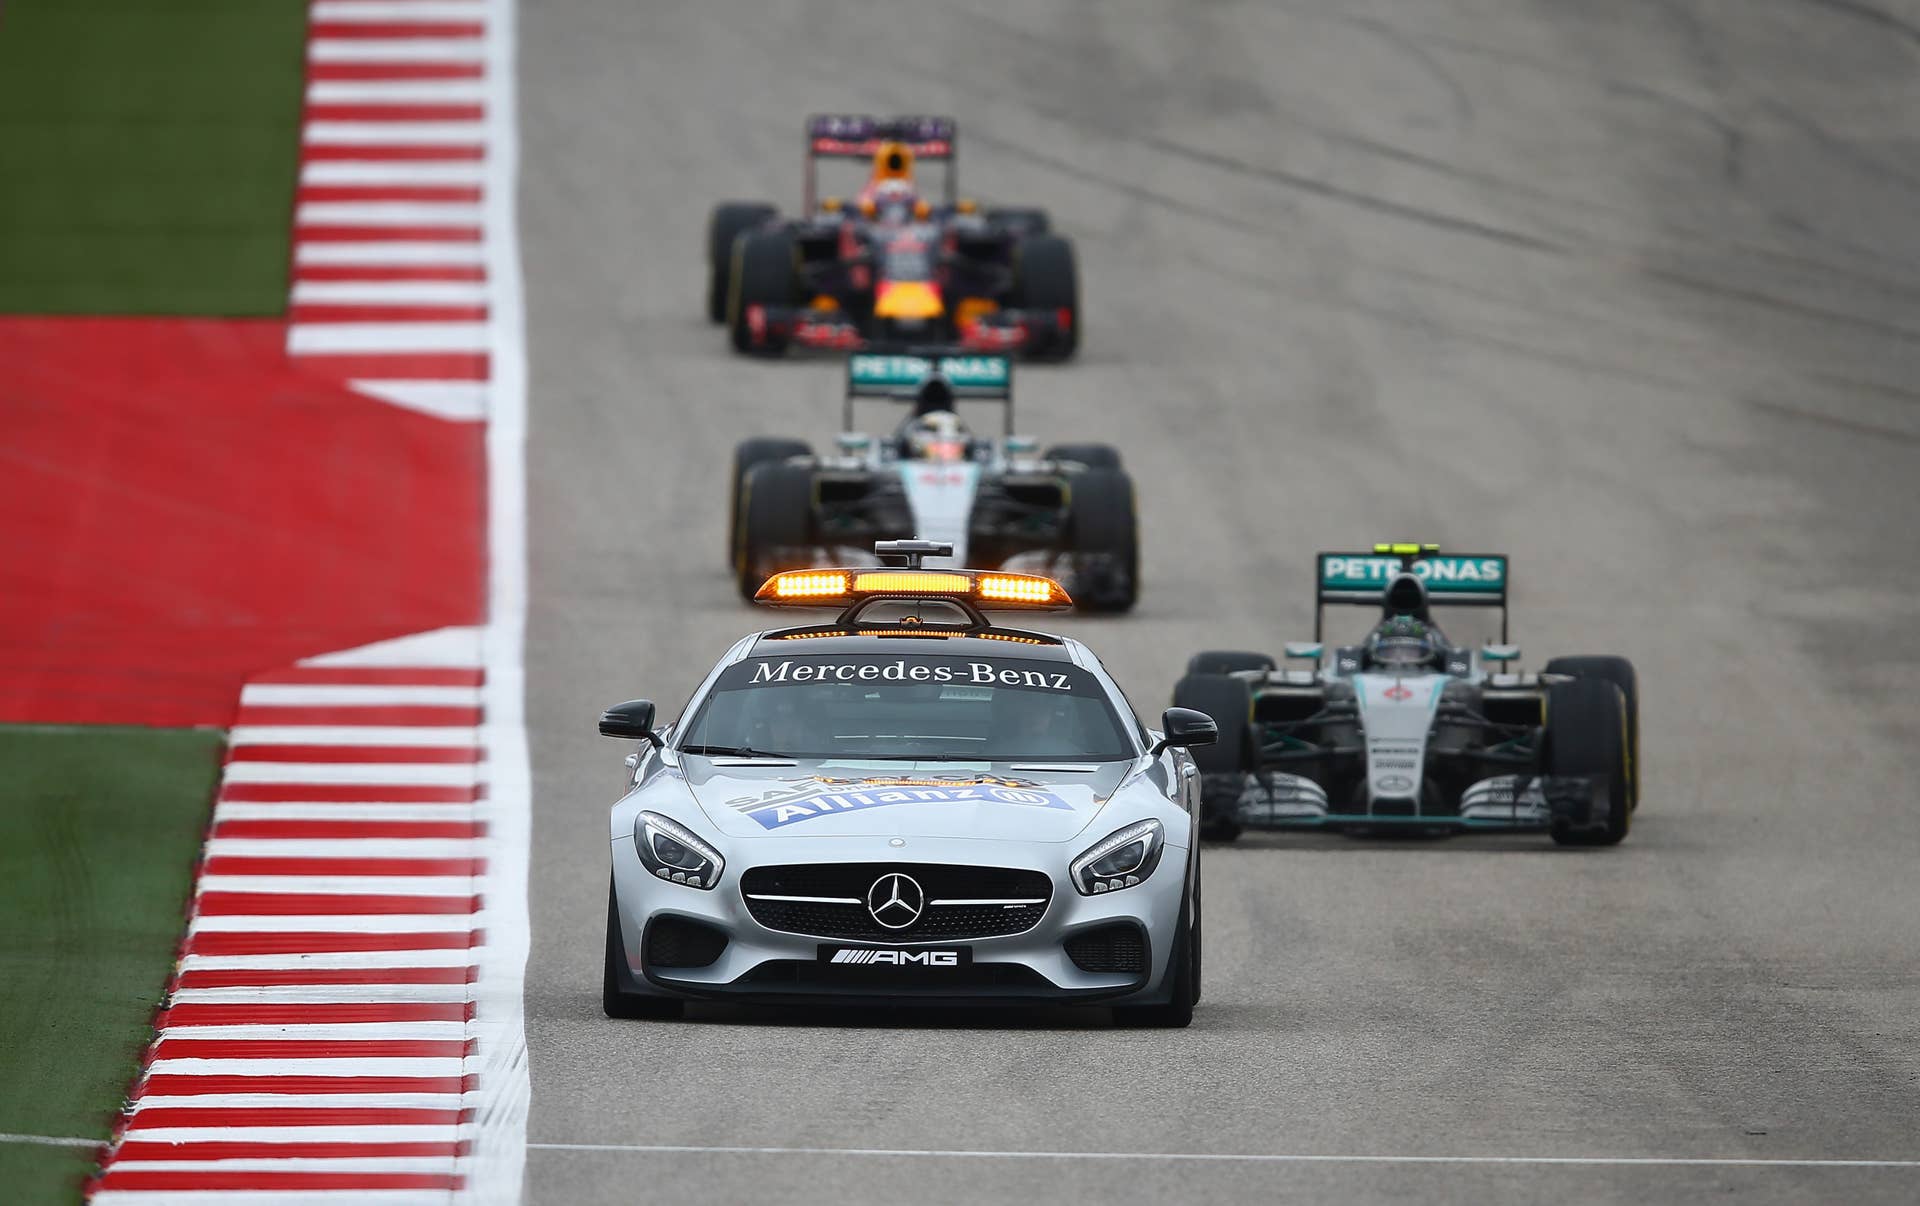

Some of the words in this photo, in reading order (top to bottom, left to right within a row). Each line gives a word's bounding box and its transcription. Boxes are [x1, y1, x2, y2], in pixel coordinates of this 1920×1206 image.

[749, 661, 1072, 690] Mercedes-Benz
[771, 787, 983, 823] Allianz
[867, 950, 958, 966] AMG
